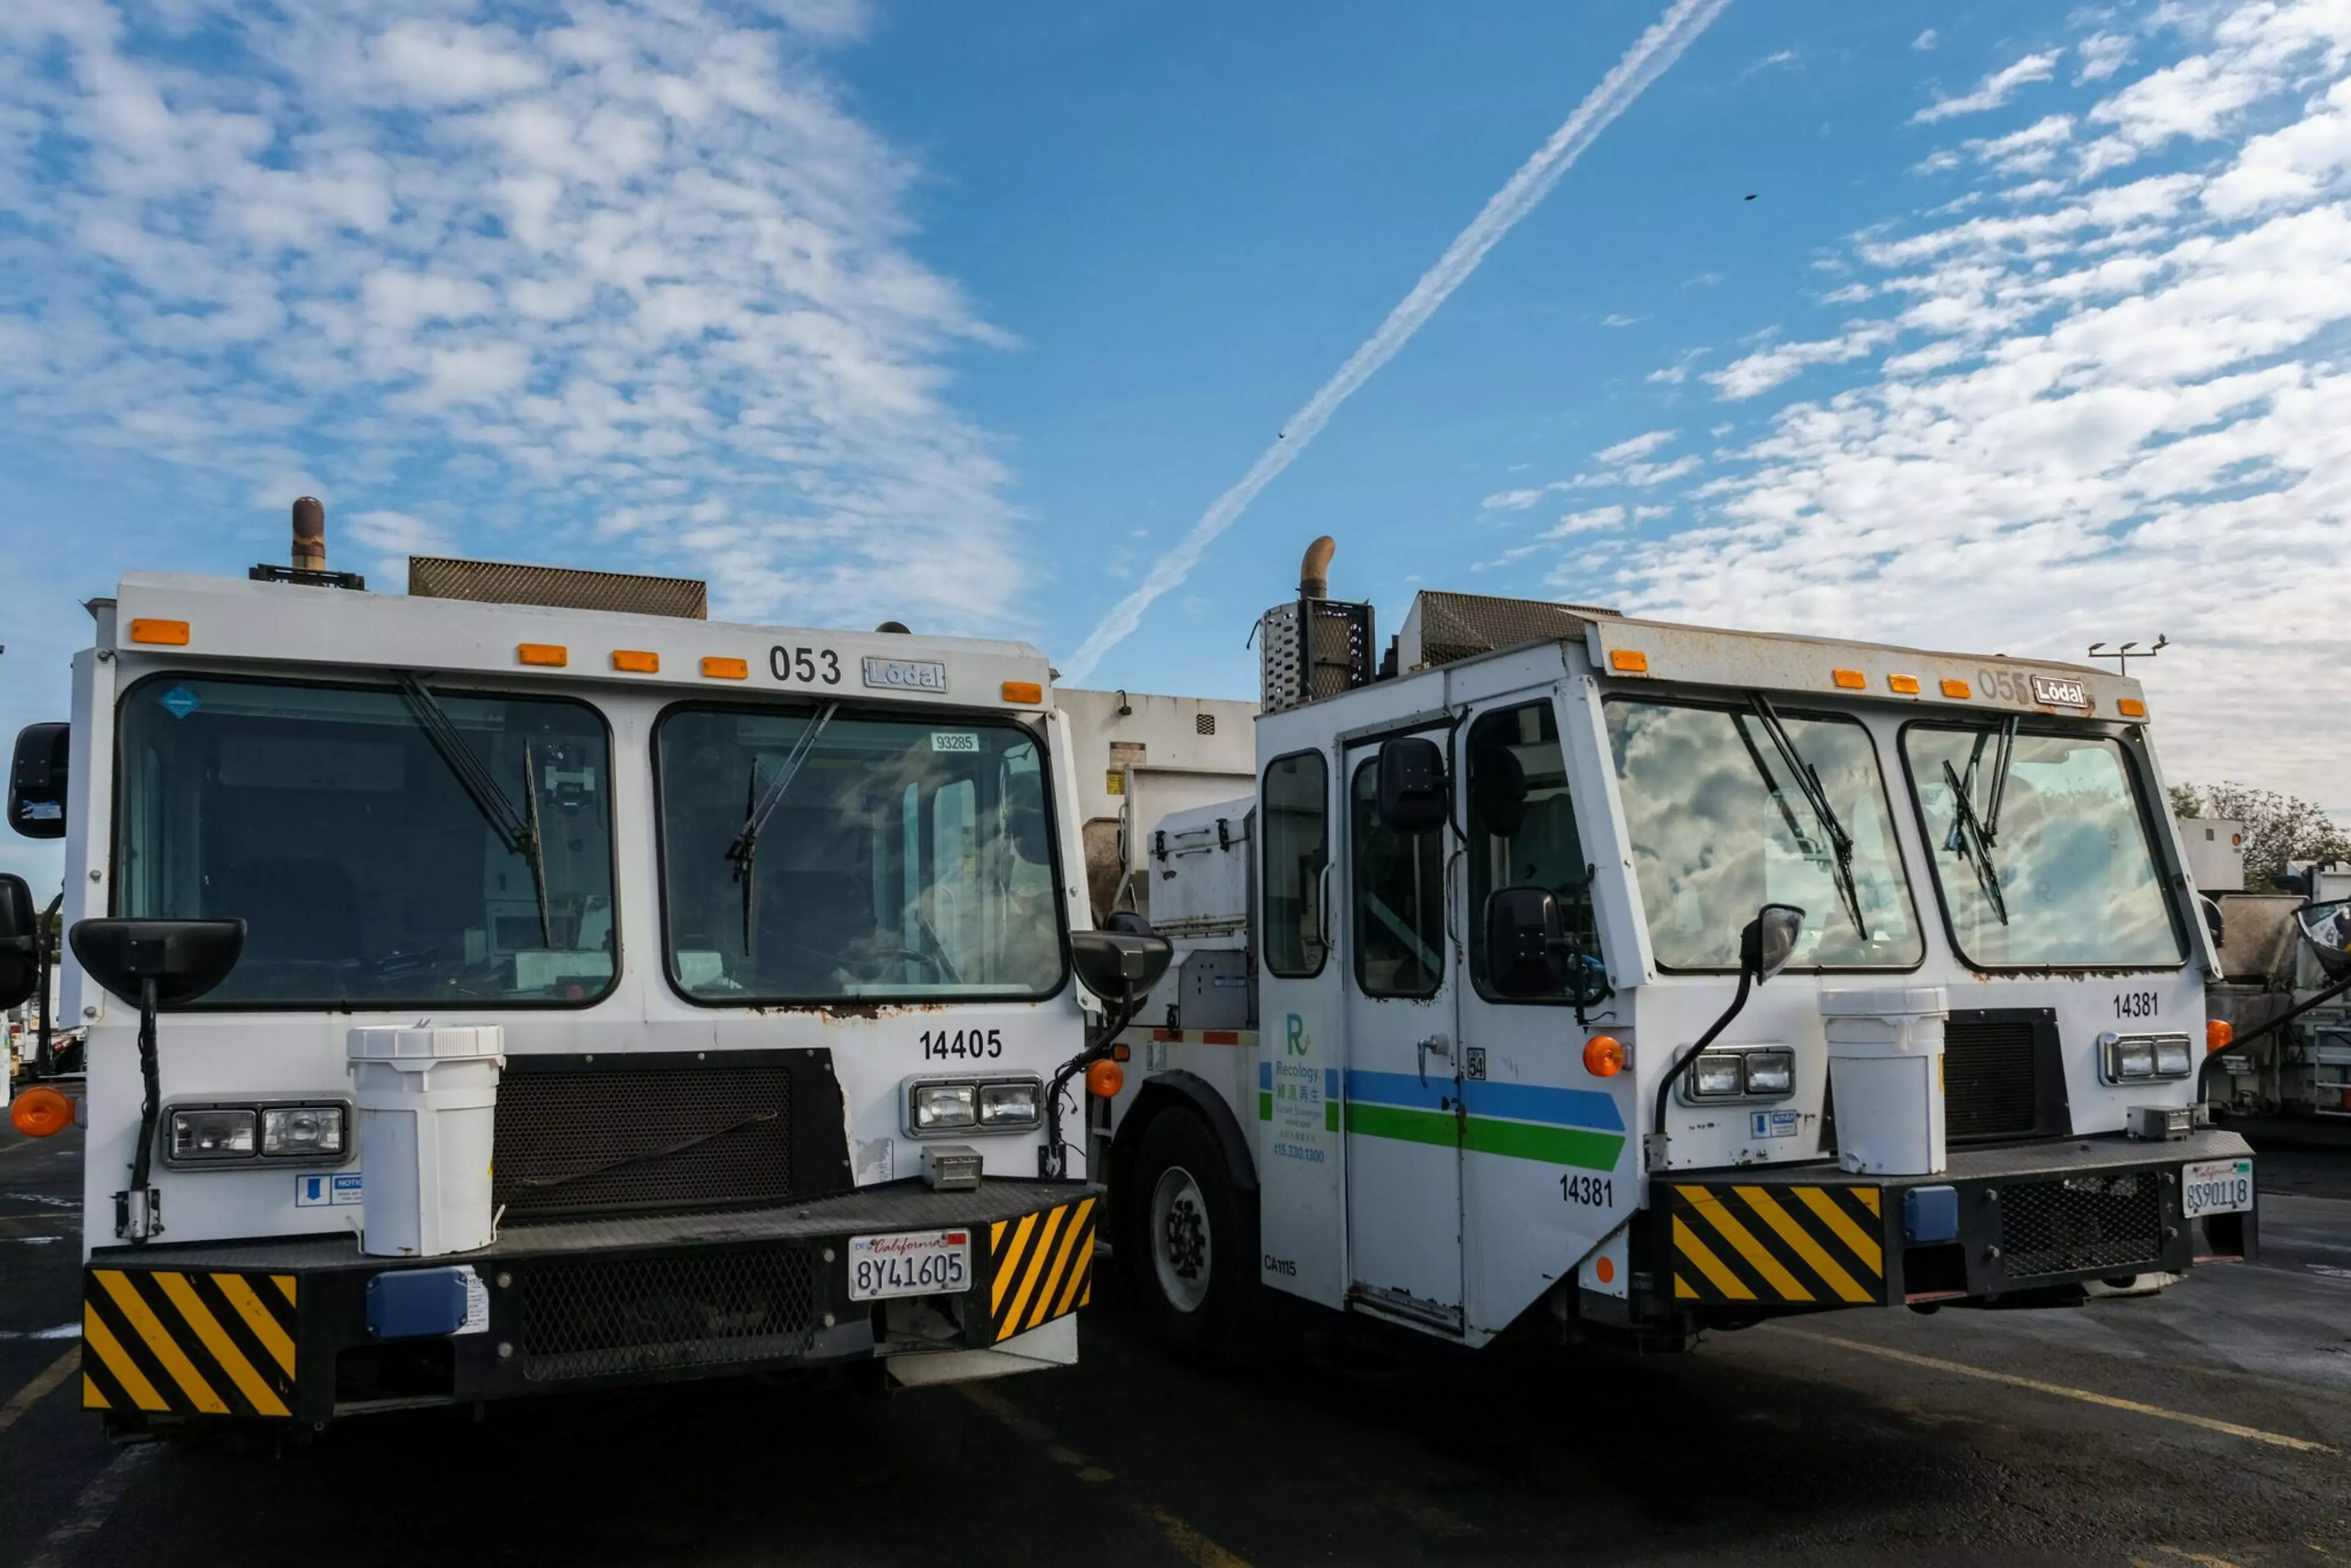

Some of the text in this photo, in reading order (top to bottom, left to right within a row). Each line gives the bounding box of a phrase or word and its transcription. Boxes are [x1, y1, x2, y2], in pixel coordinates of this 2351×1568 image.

[770, 645, 841, 685] 053
[936, 736, 973, 749] 93285
[2113, 991, 2158, 1019] 14381
[920, 1029, 1002, 1060] 14405
[1275, 1060, 1319, 1084] Recology
[1469, 1057, 1483, 1077] 54
[337, 1179, 362, 1187] NOTIC
[1559, 1174, 1613, 1209] 14381
[2187, 1179, 2248, 1209] 8S90118
[874, 1236, 946, 1256] California
[858, 1253, 962, 1290] 8Y41605
